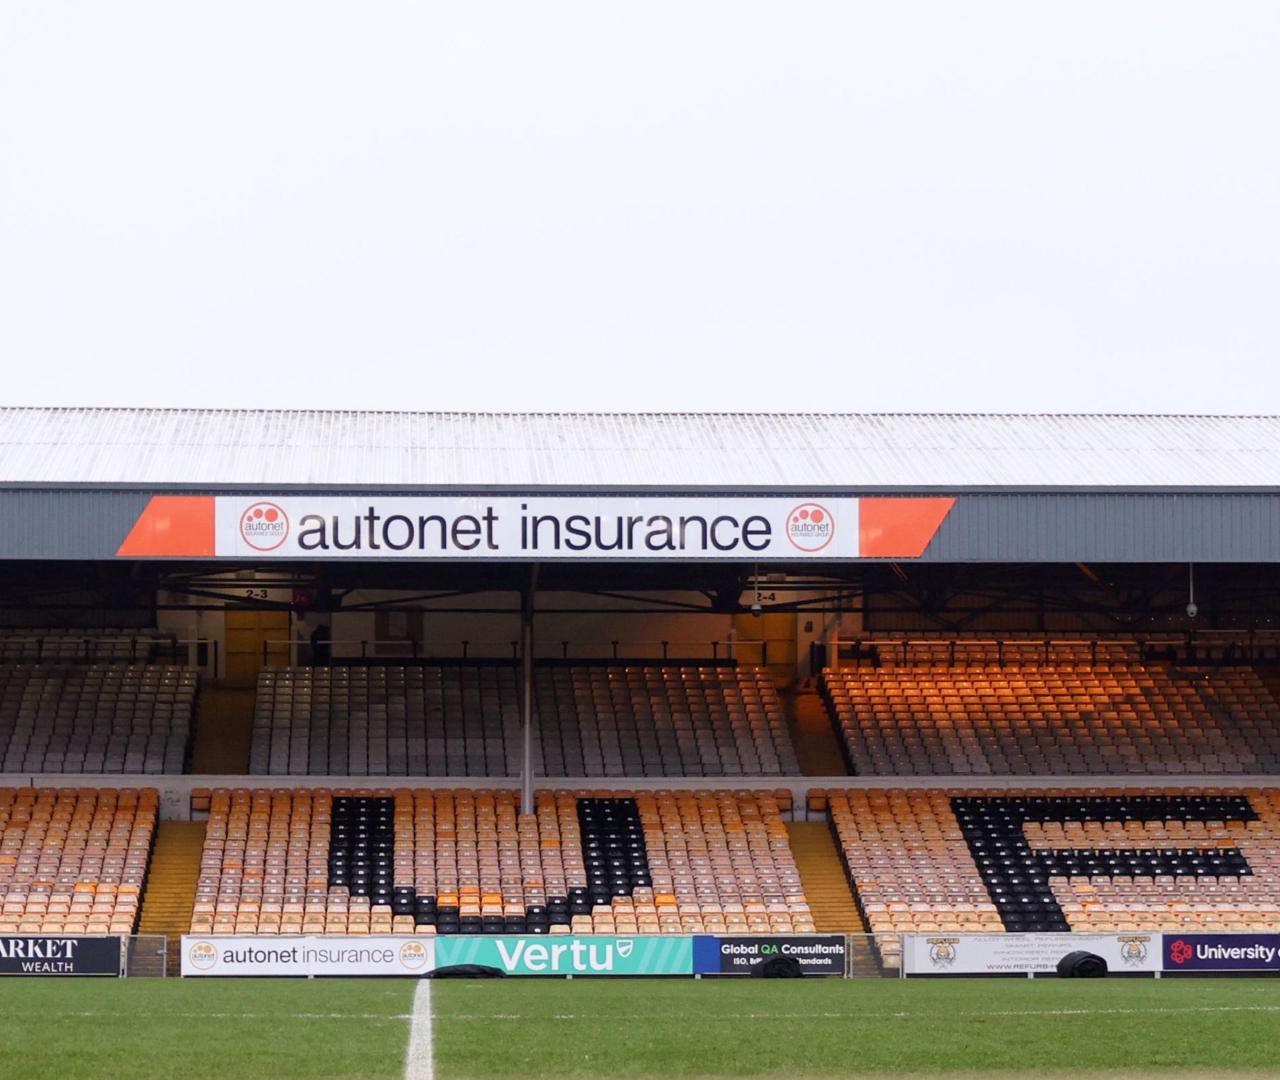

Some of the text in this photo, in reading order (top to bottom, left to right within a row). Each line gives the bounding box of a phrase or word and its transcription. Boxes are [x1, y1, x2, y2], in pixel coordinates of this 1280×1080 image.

[245, 522, 283, 531] autonet
[297, 503, 773, 552] autonet insurance
[791, 522, 829, 531] autonet
[245, 590, 268, 599] 2-3
[756, 592, 776, 602] 2-4
[950, 797, 1259, 932] F
[223, 945, 395, 964] autonet insurance
[495, 939, 614, 971] Vertu
[721, 944, 844, 955] Global QA Consultants
[1196, 944, 1276, 963] University
[21, 961, 73, 972] WEALTH
